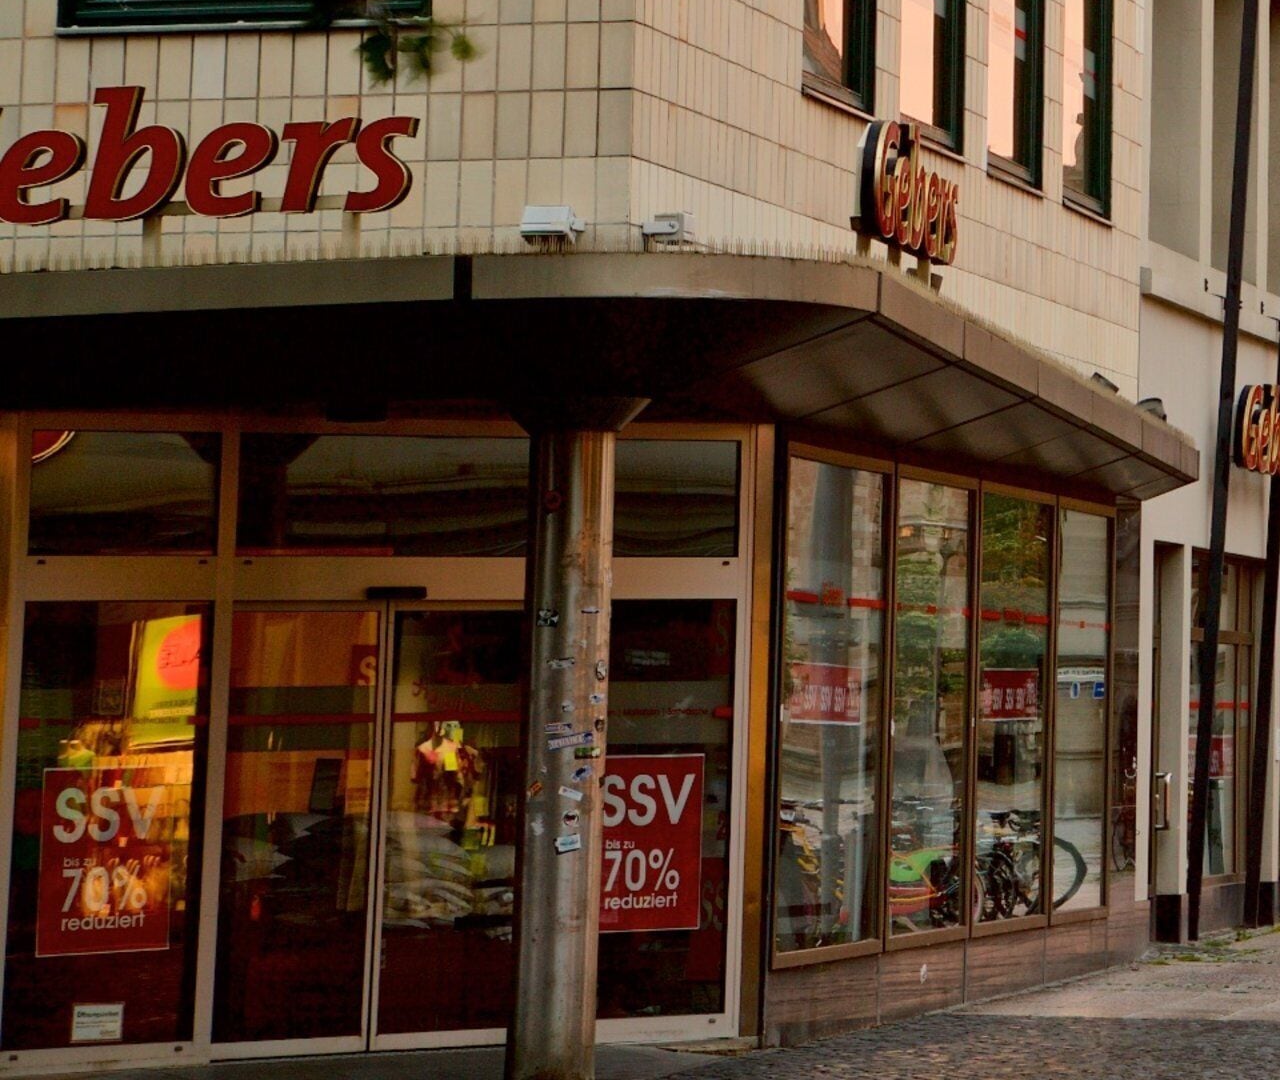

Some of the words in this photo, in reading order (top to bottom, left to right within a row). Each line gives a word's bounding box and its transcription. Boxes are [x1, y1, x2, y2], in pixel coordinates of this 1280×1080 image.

[0, 84, 422, 227] ebers
[866, 120, 960, 265] Gebers
[52, 785, 166, 844] SSV
[603, 773, 697, 828] SSV
[62, 856, 81, 868] bis
[83, 858, 97, 867] zu
[605, 840, 621, 850] bis
[623, 841, 636, 850] zu
[60, 865, 148, 913] 70%
[603, 848, 681, 893] 70%
[60, 911, 146, 932] reduziert
[604, 891, 679, 911] reduziert
